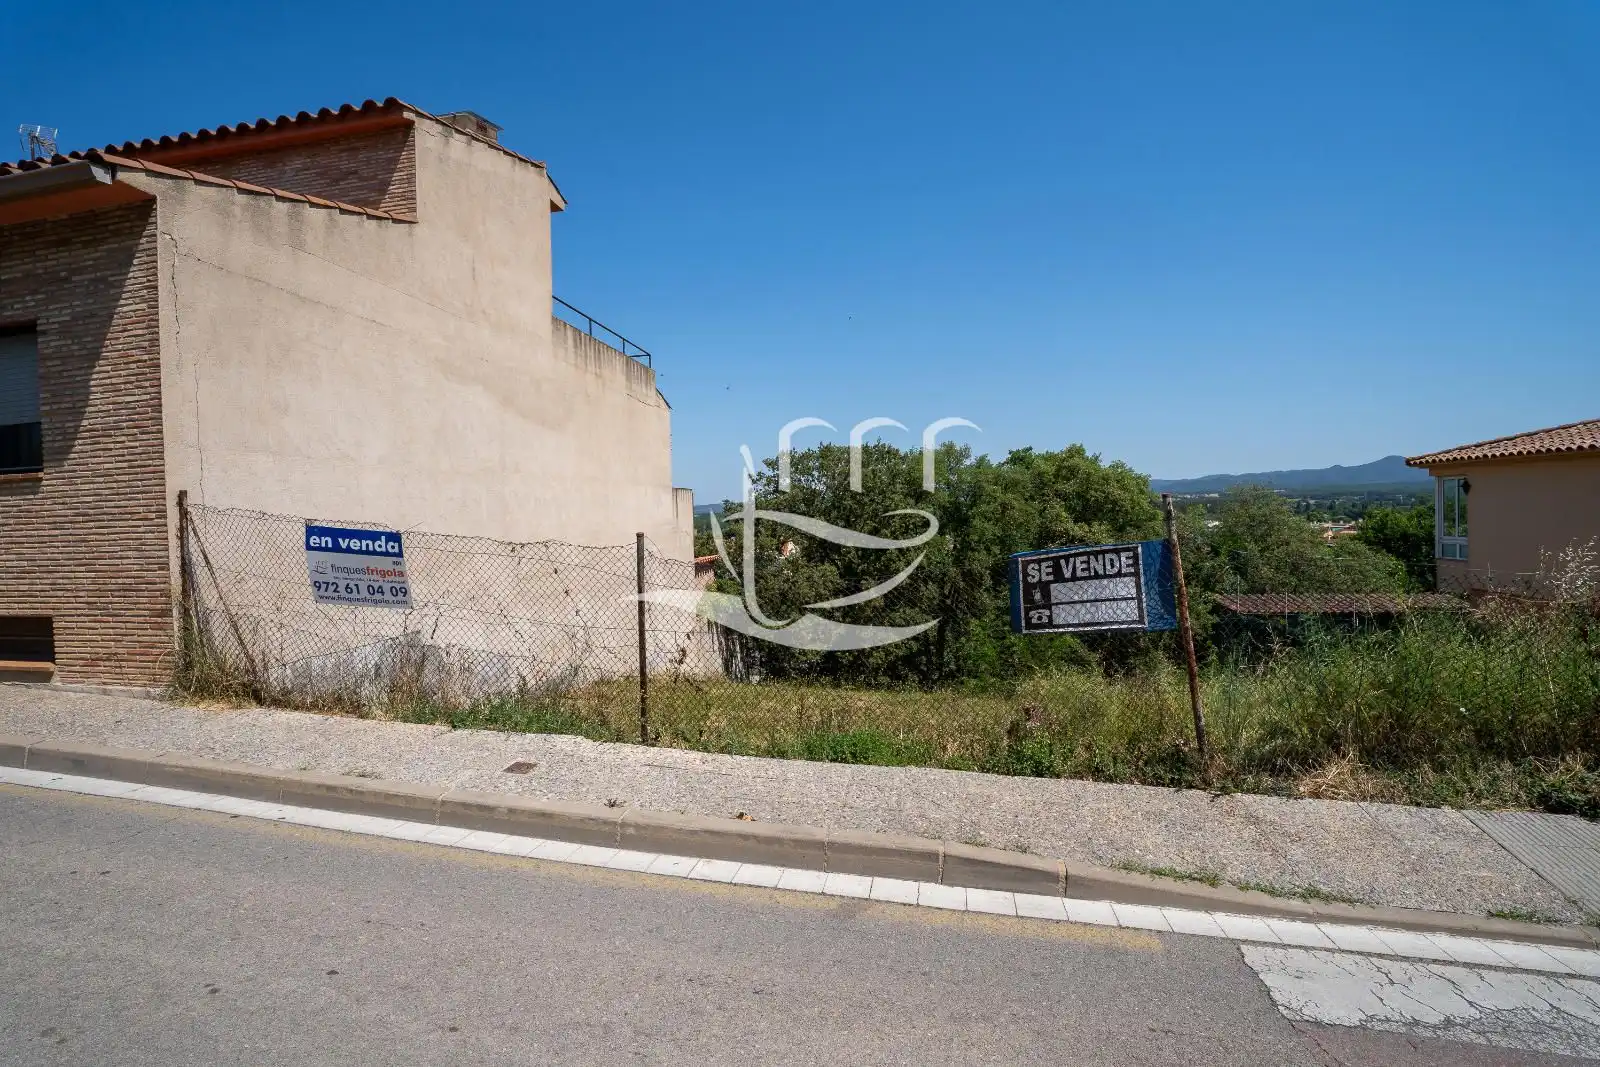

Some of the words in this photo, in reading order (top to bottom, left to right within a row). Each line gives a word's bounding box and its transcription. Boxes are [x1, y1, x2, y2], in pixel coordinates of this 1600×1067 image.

[309, 535, 332, 548] en
[338, 535, 400, 553] venda
[331, 564, 405, 578] finquesfrigola
[1026, 560, 1054, 584] SE
[1059, 551, 1136, 579] VENDE
[313, 580, 340, 594] 972
[345, 583, 361, 595] 61
[366, 584, 385, 596] 04
[390, 586, 408, 598] 09
[318, 594, 408, 605] www.finquesfrigola.com
